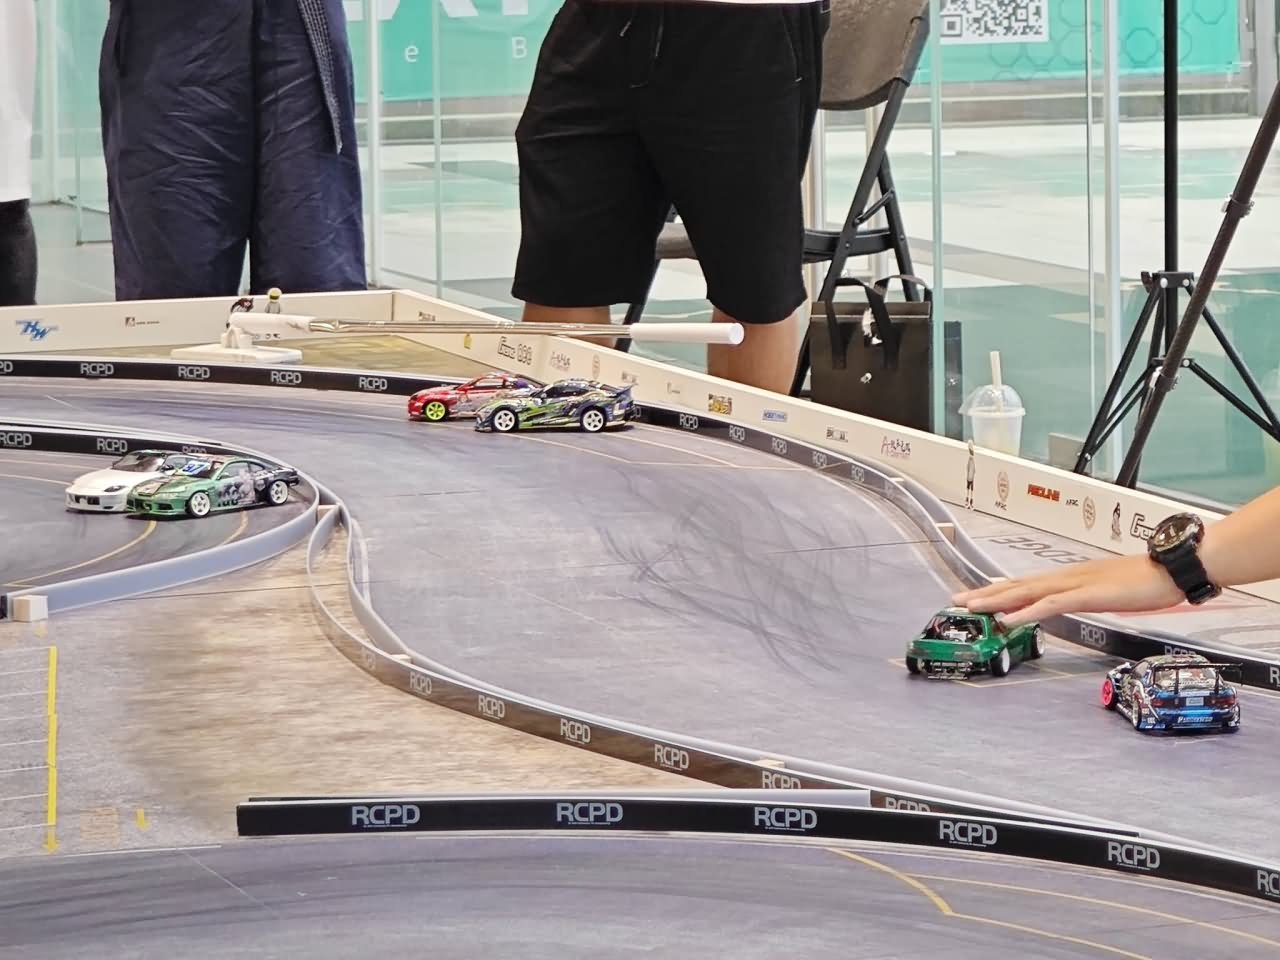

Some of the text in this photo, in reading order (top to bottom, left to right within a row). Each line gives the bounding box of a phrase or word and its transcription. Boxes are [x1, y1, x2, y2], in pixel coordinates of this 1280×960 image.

[80, 362, 114, 376] RCPD
[178, 366, 210, 379] RCPD
[271, 371, 301, 384] RCPD
[359, 377, 388, 390] RCPD
[680, 413, 698, 429] RCPD
[729, 424, 745, 440] RCPD
[97, 438, 128, 453] RCPD
[771, 437, 788, 454] RCPD
[1081, 624, 1106, 644] RCPD
[410, 671, 432, 694] RCPD
[478, 695, 505, 718] RCPD
[560, 719, 591, 744] RCPD
[655, 744, 689, 769] RCPD
[762, 771, 801, 789] RCPD
[351, 804, 421, 825] RCPD
[556, 802, 623, 824] RCPD
[754, 807, 817, 830] RCPD
[939, 820, 997, 845] RCPD
[1108, 841, 1160, 868] RCPD
